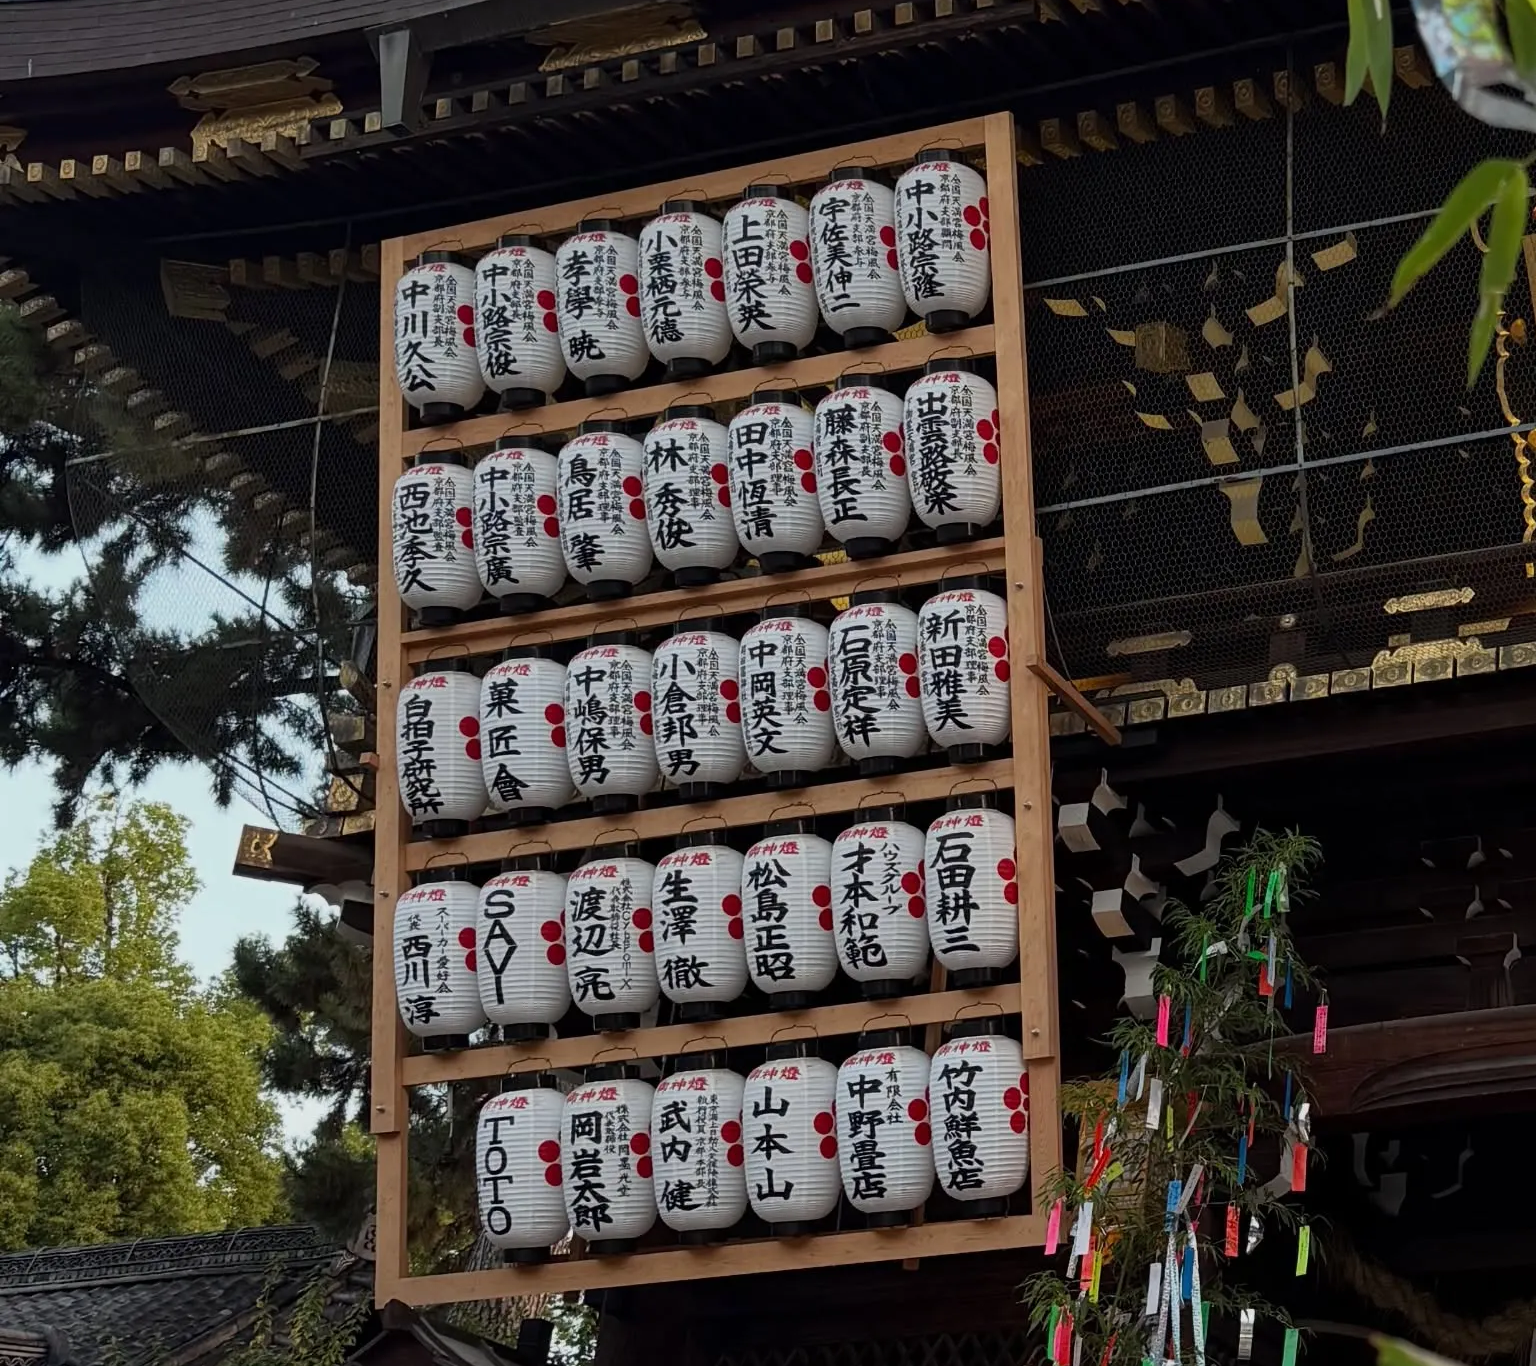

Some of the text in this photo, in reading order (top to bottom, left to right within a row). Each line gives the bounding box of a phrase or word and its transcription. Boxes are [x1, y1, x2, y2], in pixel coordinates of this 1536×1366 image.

[819, 198, 860, 313] 宇佐美伸二
[905, 180, 945, 301] 中小路宗隆
[401, 280, 438, 391] 中川久公
[482, 264, 522, 379] 中小路宗俊
[824, 403, 868, 525] 藤森長正
[399, 482, 437, 593] 西池季久
[660, 653, 701, 777] 小倉邦男
[748, 640, 789, 757] 中岡英文
[837, 624, 882, 747] 石原定祥
[925, 609, 974, 733] 新田雅美
[482, 889, 518, 1005] SAY
[746, 858, 796, 982] 松島正昭
[929, 831, 981, 956] 石田耕三
[752, 1086, 796, 1202] 山本山
[847, 1075, 888, 1201] 中野畳店
[885, 1068, 904, 1125] 有限会社
[937, 1060, 986, 1192] 竹内鮮魚店
[483, 1115, 515, 1235] TOTO
[568, 1110, 613, 1233] 岡岩太郎
